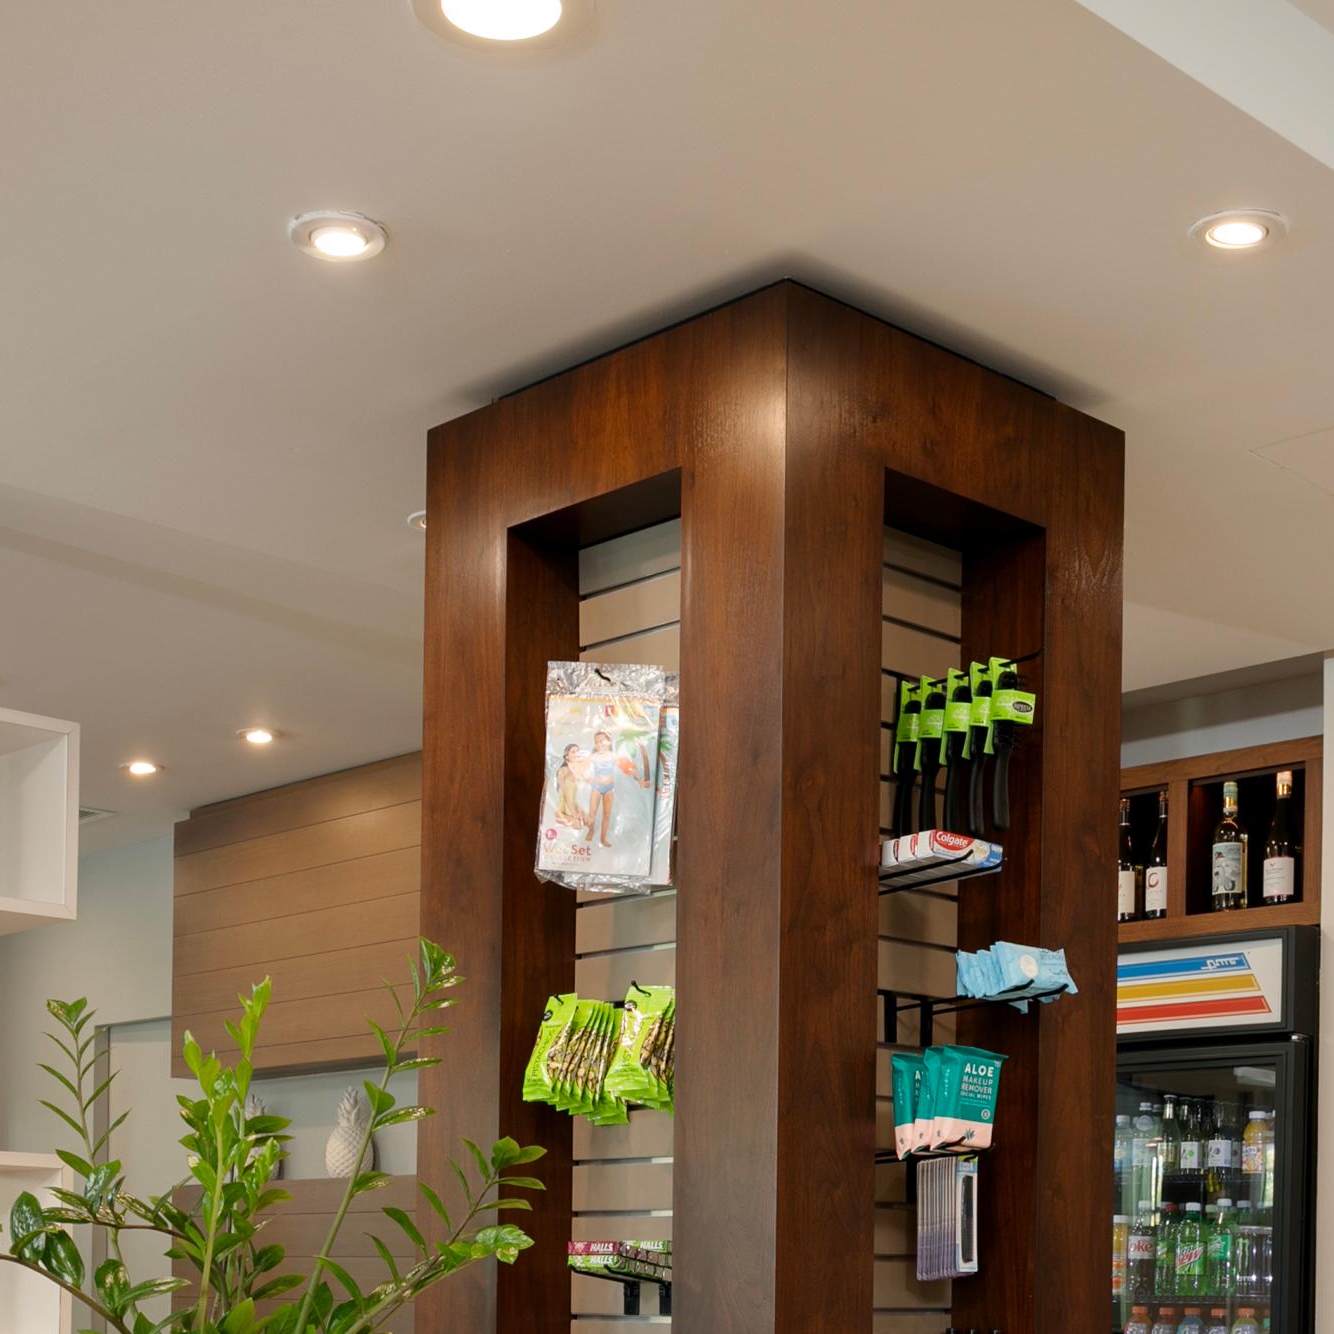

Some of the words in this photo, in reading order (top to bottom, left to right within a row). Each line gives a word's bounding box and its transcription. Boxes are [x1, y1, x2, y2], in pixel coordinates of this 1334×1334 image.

[936, 831, 968, 847] Colgate
[571, 844, 591, 856] Set
[964, 1063, 994, 1077] ALOE
[963, 1075, 993, 1086] MAKEUP
[962, 1083, 992, 1094] REMOVER
[590, 1242, 613, 1252] HALLS
[640, 1241, 663, 1250] HALLS
[1130, 1240, 1153, 1253] oke
[590, 1255, 613, 1265] HALLS
